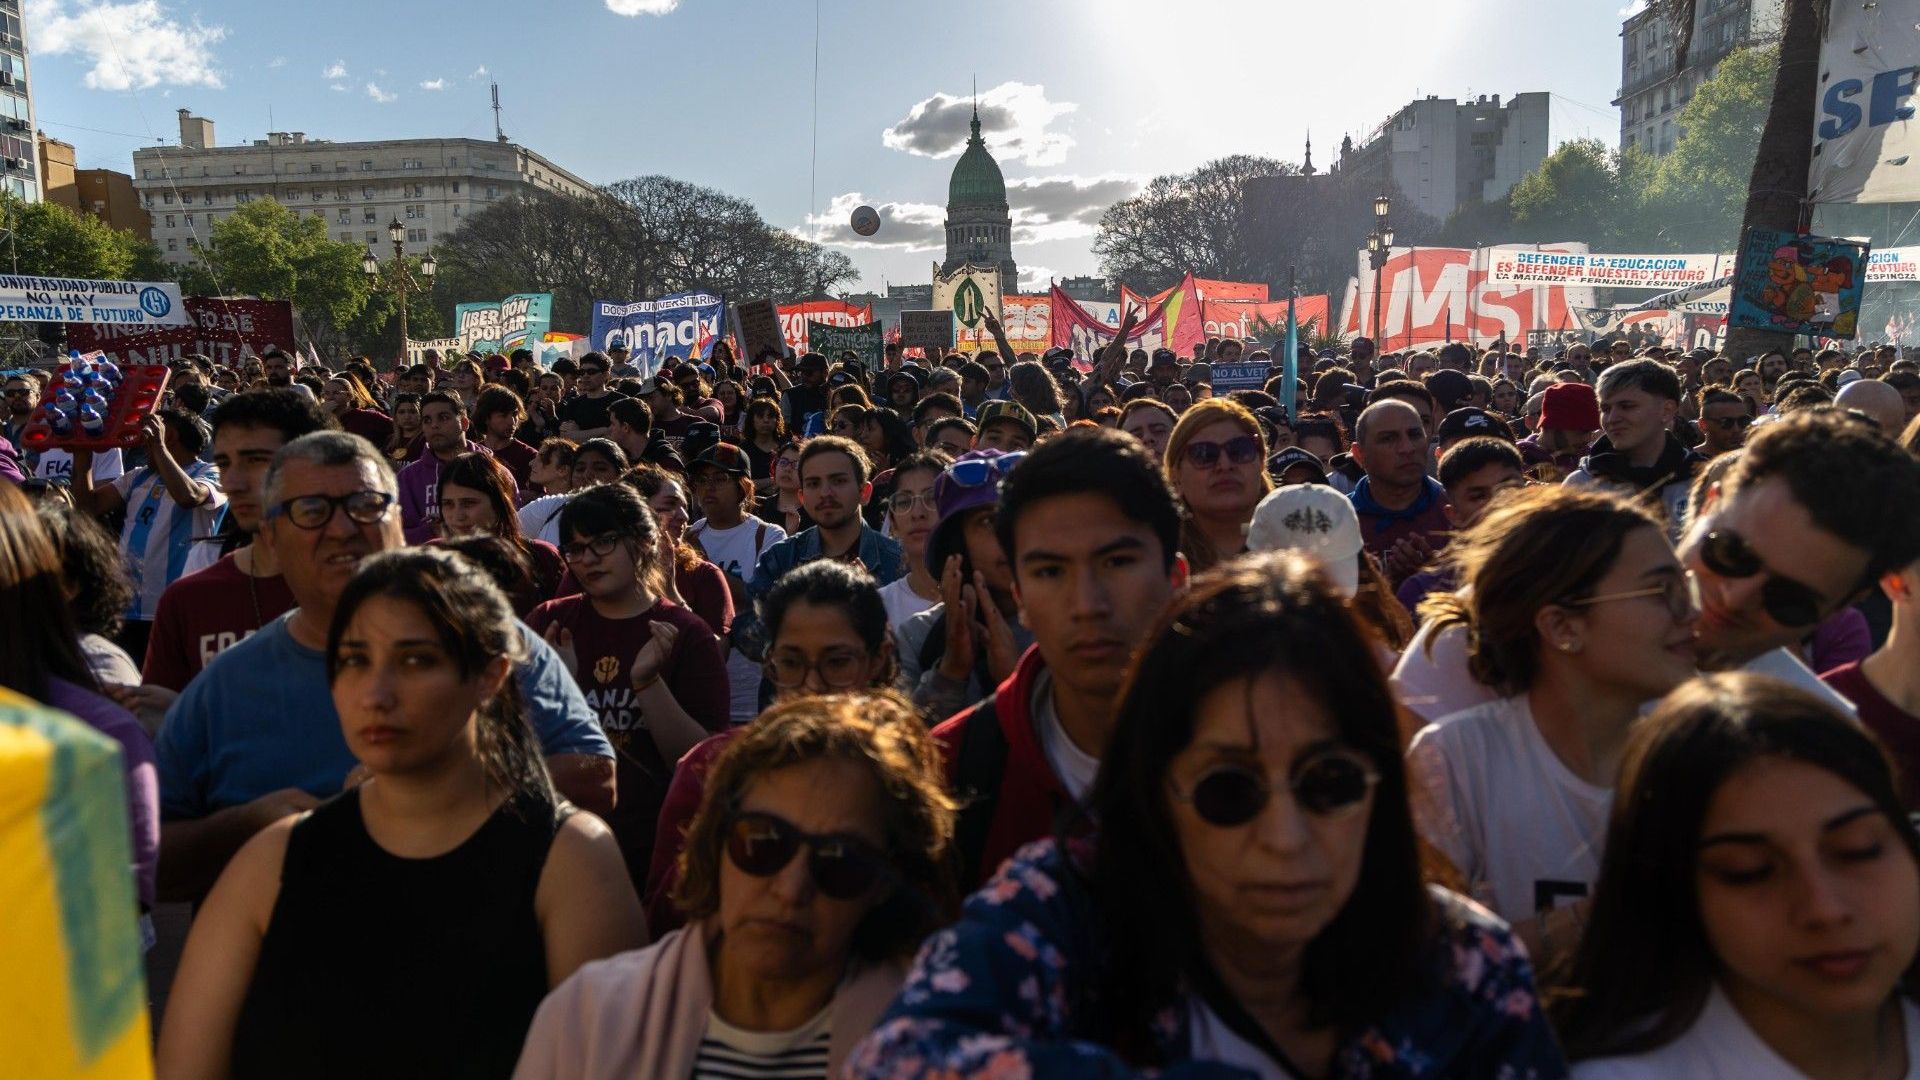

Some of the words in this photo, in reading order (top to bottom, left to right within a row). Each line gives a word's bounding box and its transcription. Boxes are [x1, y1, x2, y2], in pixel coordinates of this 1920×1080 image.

[1518, 253, 1585, 266] DEFENDER
[1590, 257, 1605, 267] LA
[1610, 258, 1687, 269] EDUCACION
[1871, 263, 1916, 272] FUTURO
[1497, 262, 1513, 272] ES
[1516, 263, 1583, 276] DEFENDER
[1589, 267, 1648, 279] NUESTRO
[1653, 269, 1705, 280] FUTURO
[0, 276, 88, 293] UNIVERSIDAD
[91, 280, 139, 295] PUBLICA
[1513, 274, 1566, 282] MATANZA
[1580, 277, 1641, 286] FERNANDO
[26, 291, 52, 305] NO
[60, 293, 95, 306] HAY
[67, 307, 84, 321] DE
[92, 308, 144, 322] FUTURO
[1212, 369, 1228, 378] NO
[1231, 368, 1245, 377] AL
